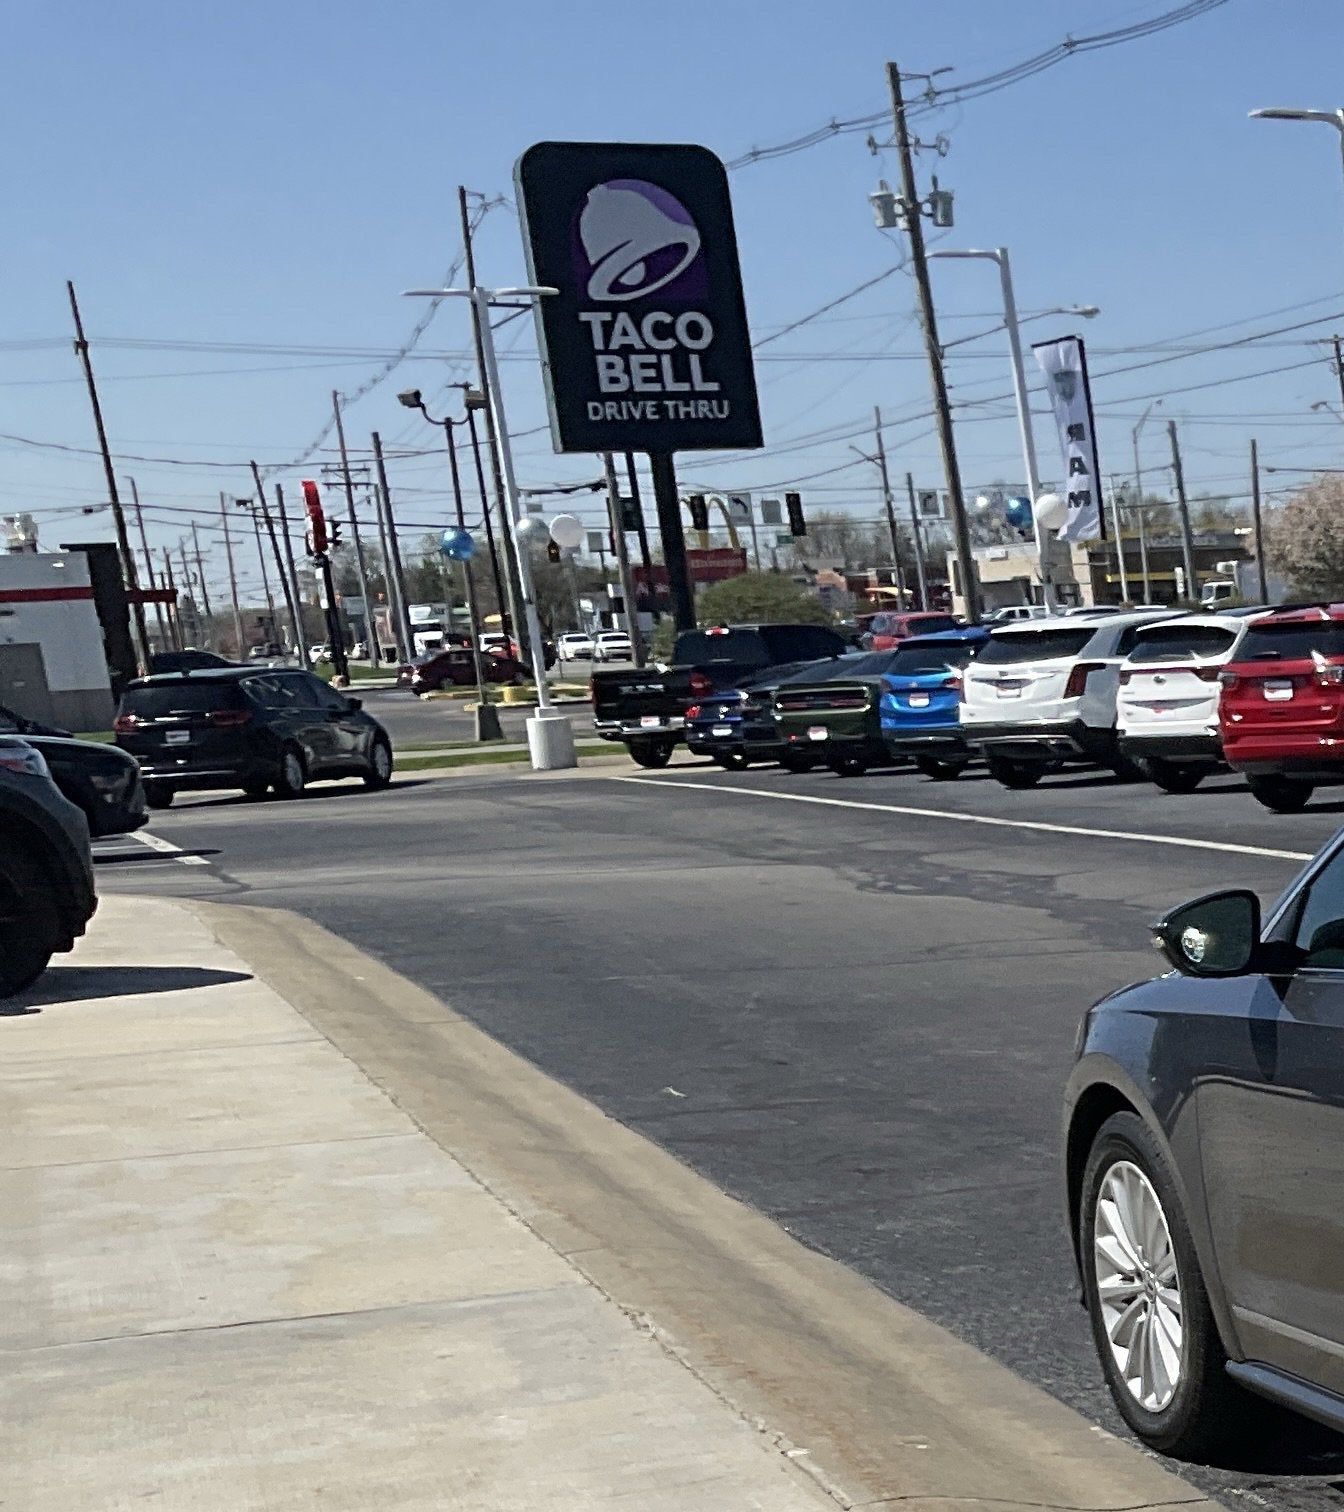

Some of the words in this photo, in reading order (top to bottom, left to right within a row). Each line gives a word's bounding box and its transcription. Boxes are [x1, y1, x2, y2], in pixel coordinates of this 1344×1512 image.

[578, 311, 713, 350] TACO
[595, 354, 721, 393] BELL
[587, 400, 660, 421] DRIVE
[663, 400, 730, 420] THRU
